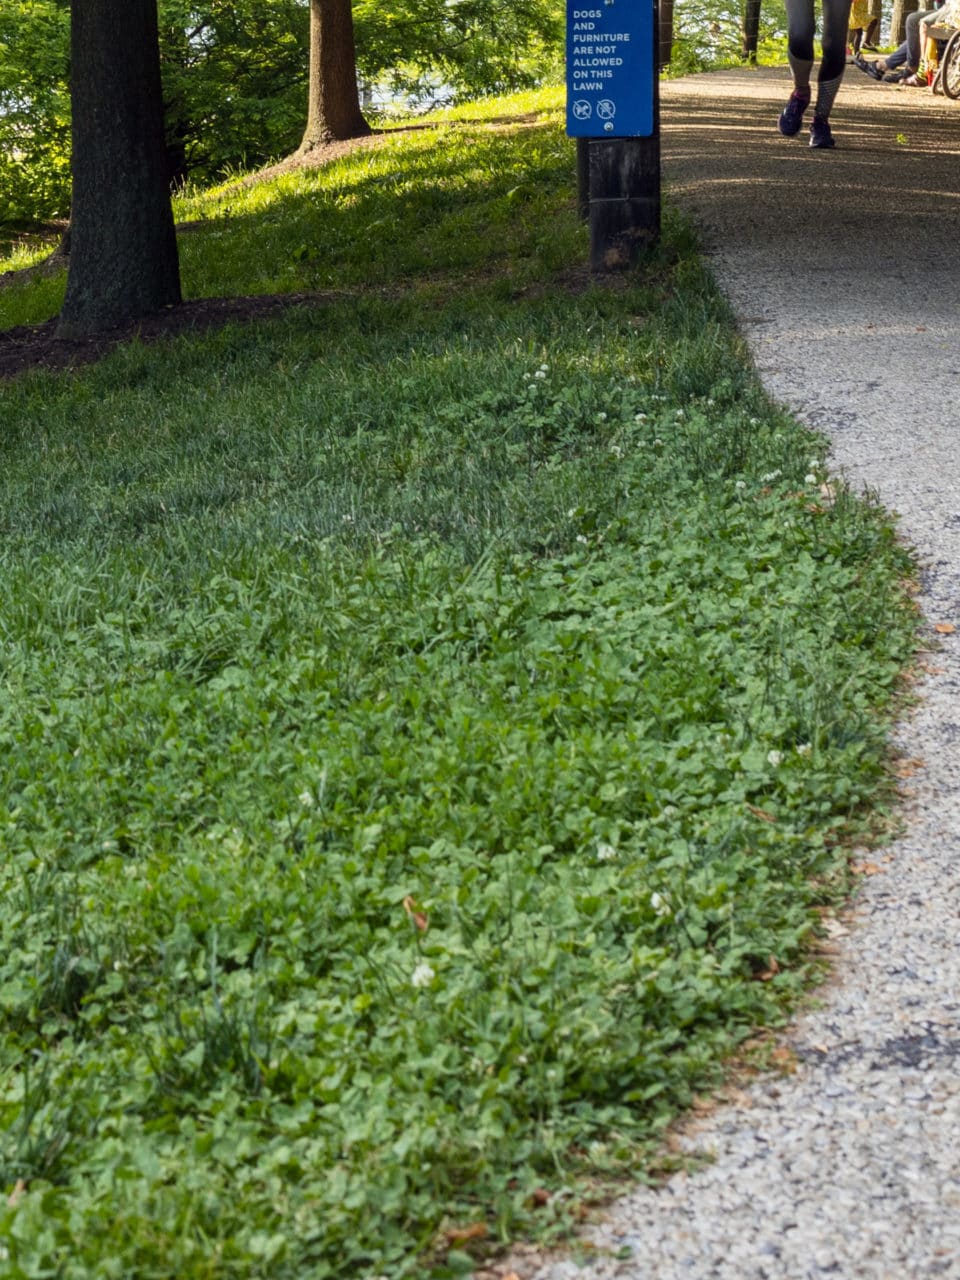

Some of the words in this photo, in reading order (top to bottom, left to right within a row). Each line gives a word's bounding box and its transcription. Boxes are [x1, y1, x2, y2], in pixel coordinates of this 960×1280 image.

[574, 10, 601, 18] DOGS
[574, 22, 595, 30] AND
[574, 33, 630, 42] FURNITURE
[574, 46, 593, 54] ARE
[596, 46, 616, 54] NOT
[574, 58, 623, 66] ALLOWED
[573, 70, 588, 78] ON
[591, 70, 613, 78] THIS
[574, 82, 602, 91] LAWN
